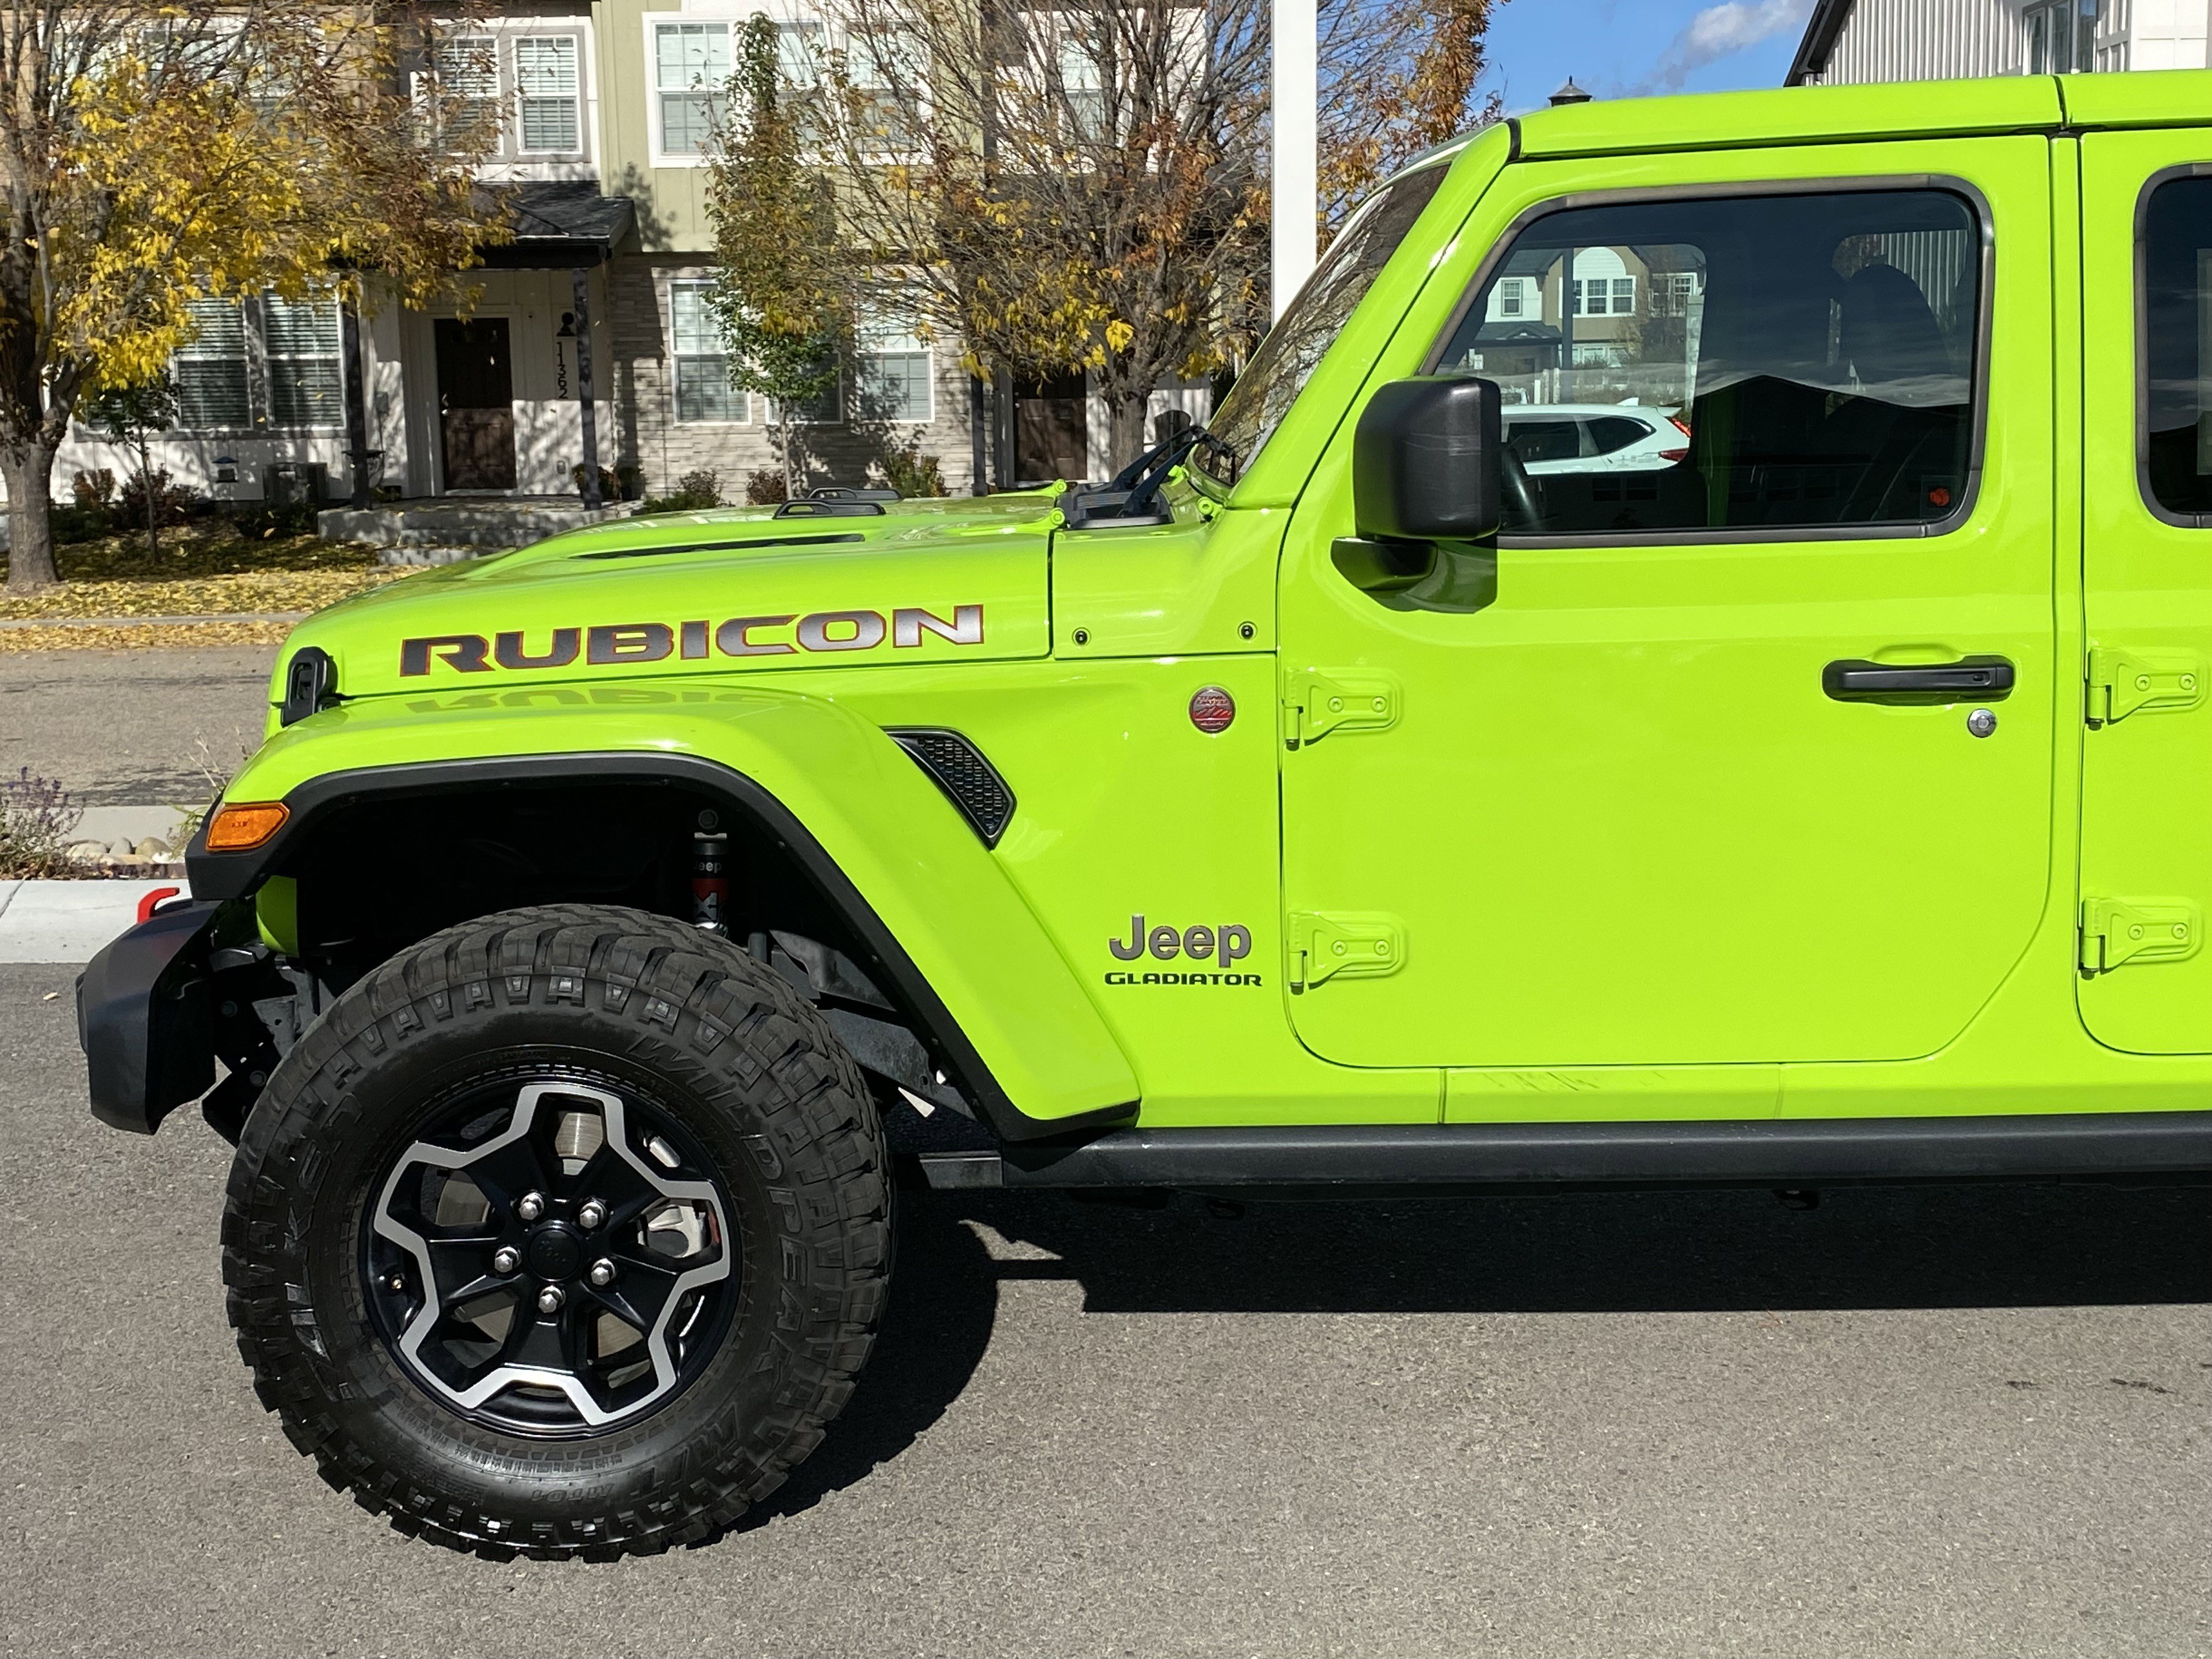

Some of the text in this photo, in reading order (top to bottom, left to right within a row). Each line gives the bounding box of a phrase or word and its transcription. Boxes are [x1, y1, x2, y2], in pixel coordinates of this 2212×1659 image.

[556, 341, 568, 399] 11362
[400, 604, 984, 677] RUBICON
[1109, 914, 1251, 968] Jeep
[1104, 972, 1262, 987] GLADIATOR
[625, 1033, 808, 1392] WILDPEAK
[531, 1483, 614, 1503] MT01
